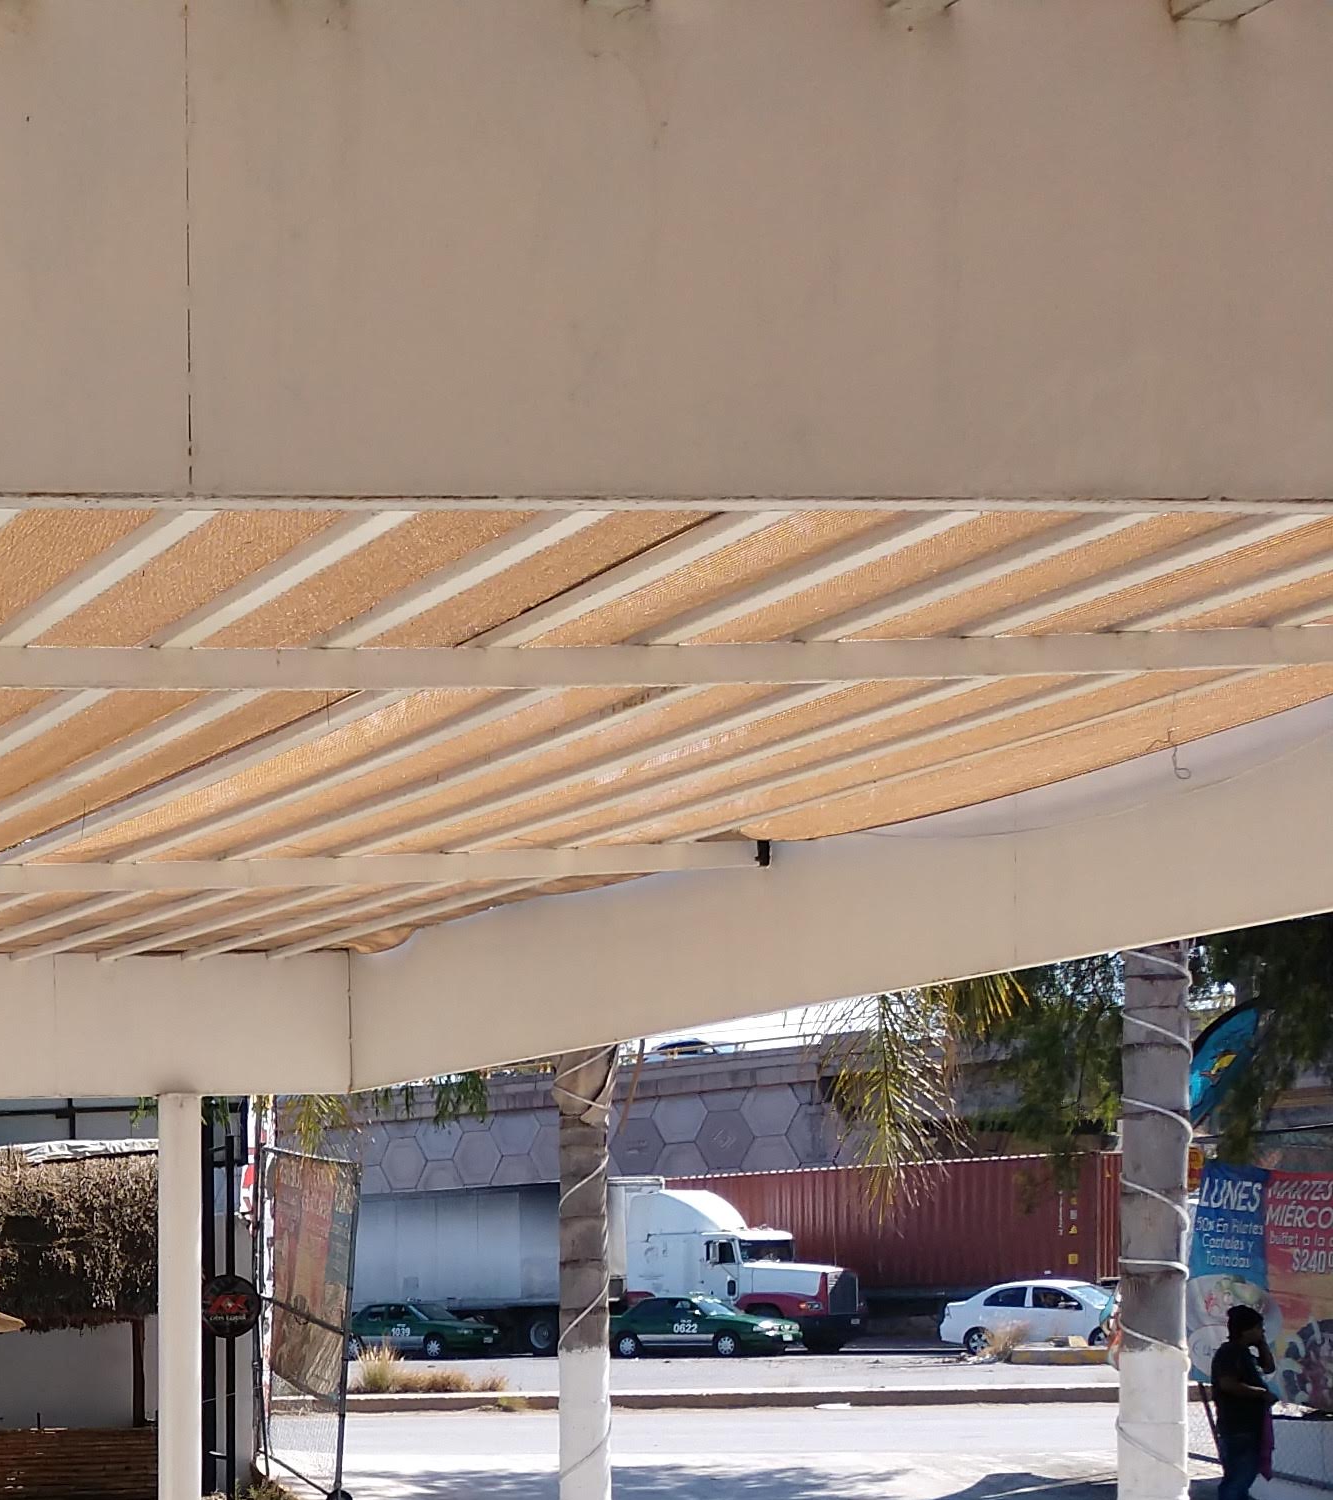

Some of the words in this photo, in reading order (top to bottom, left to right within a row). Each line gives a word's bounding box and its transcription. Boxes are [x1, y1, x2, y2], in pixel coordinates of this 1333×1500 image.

[1199, 1177, 1263, 1212] LUNES
[1268, 1180, 1333, 1201] MARTES
[1265, 1201, 1333, 1229] MIÉRCO
[391, 1327, 411, 1337] 1039
[673, 1323, 698, 1334] 0622
